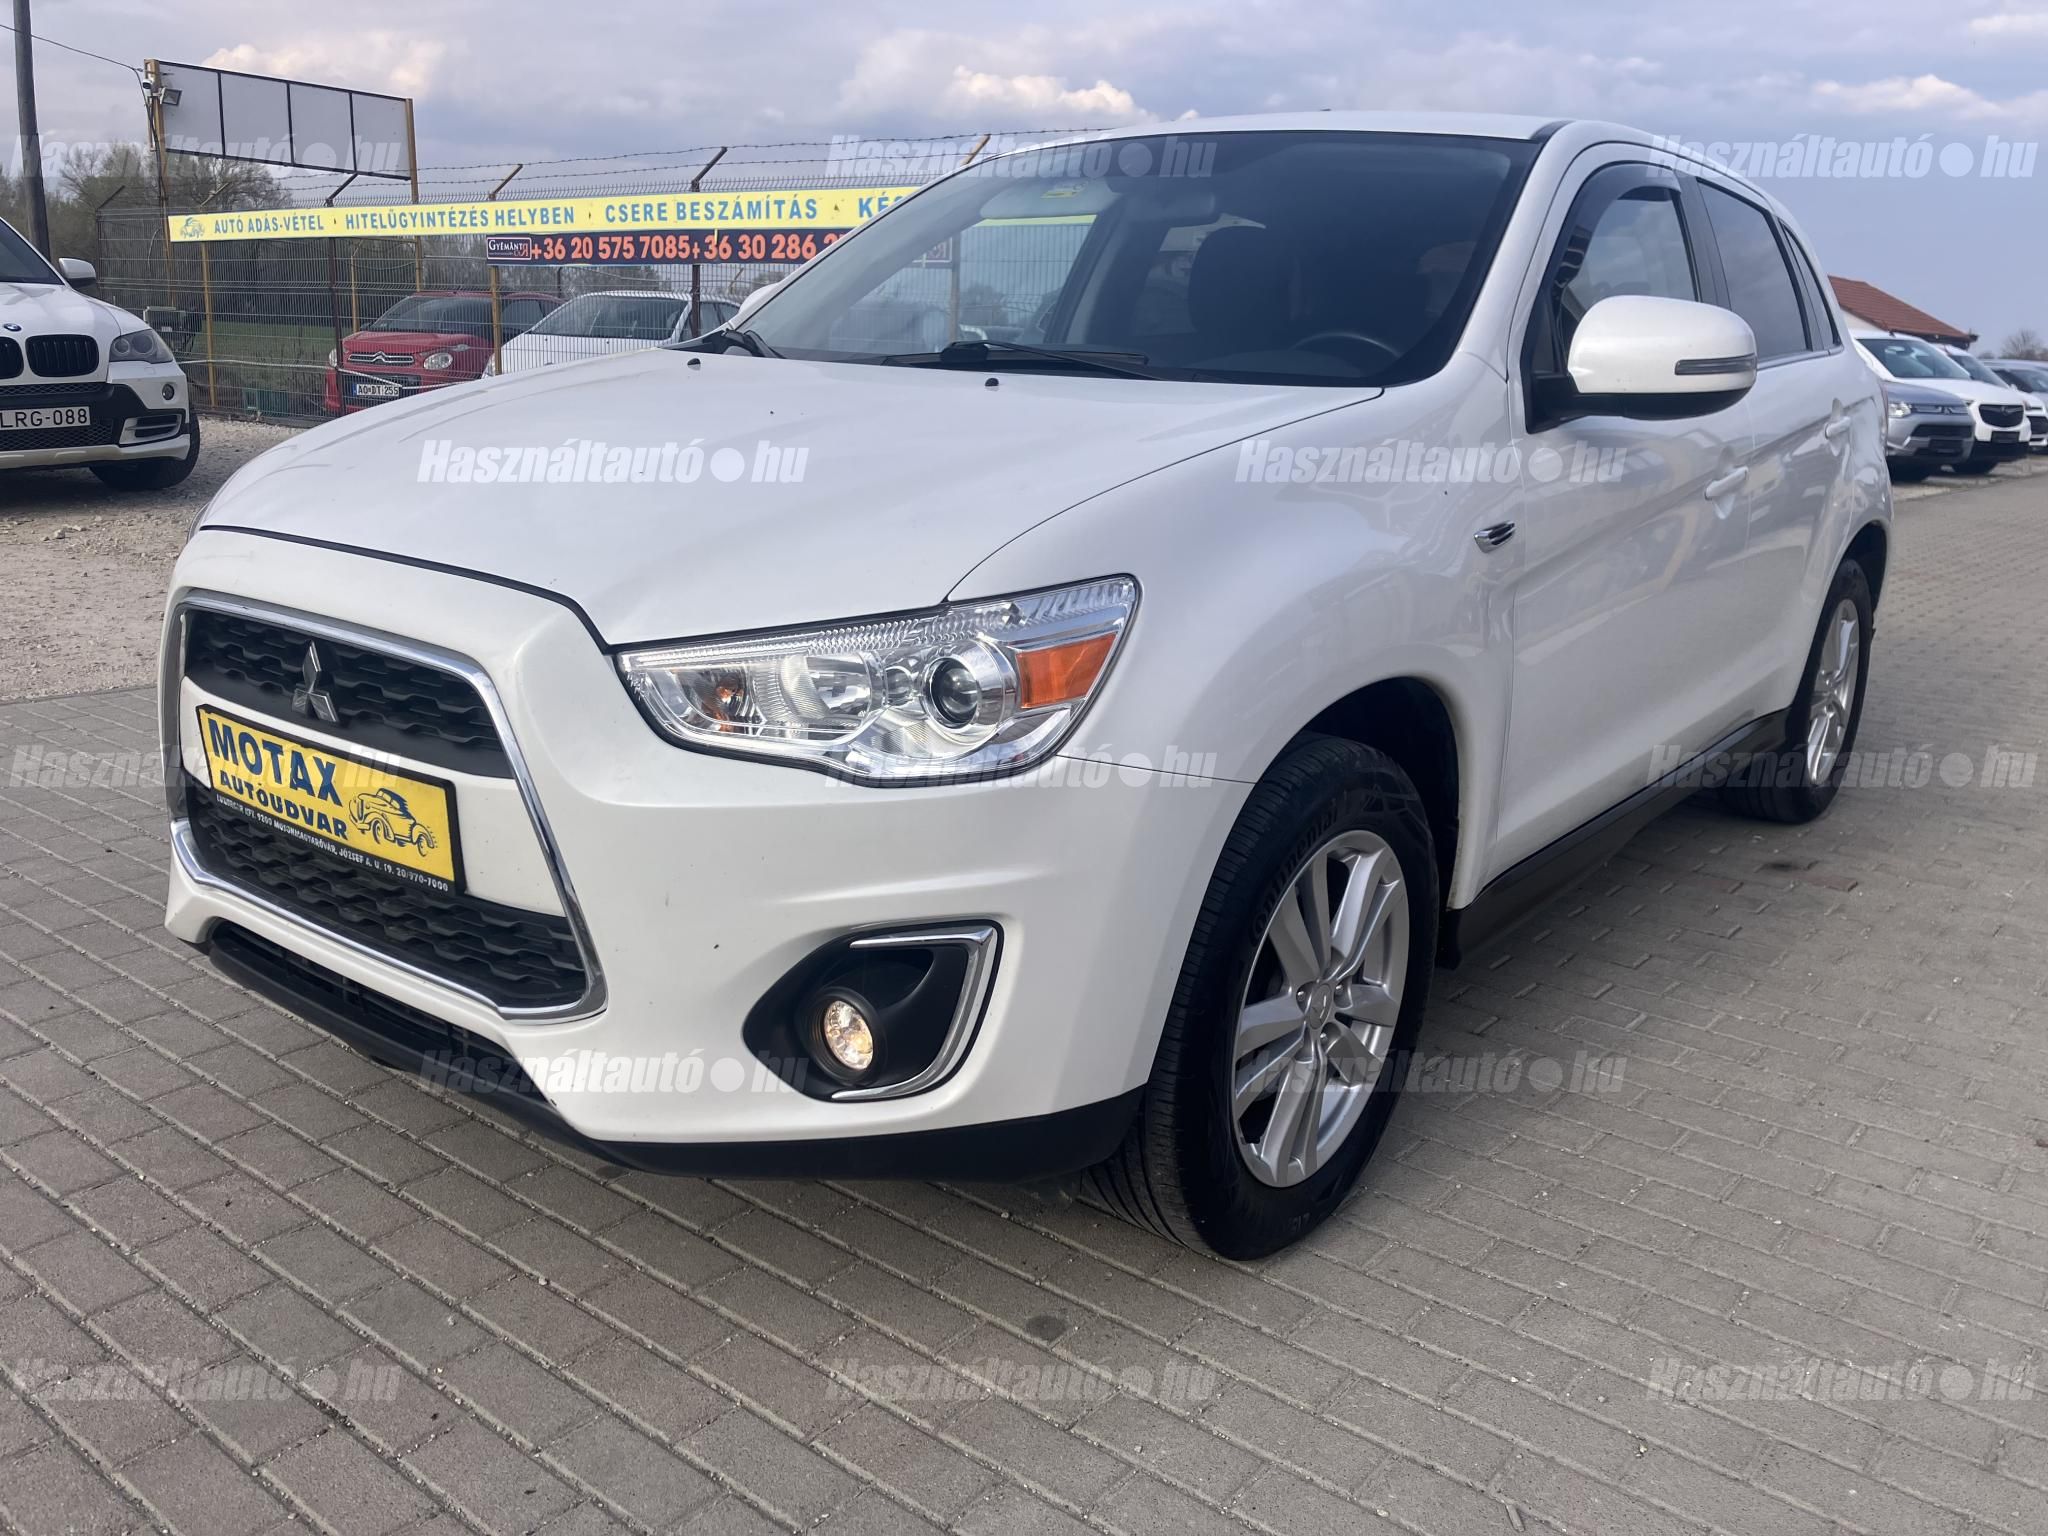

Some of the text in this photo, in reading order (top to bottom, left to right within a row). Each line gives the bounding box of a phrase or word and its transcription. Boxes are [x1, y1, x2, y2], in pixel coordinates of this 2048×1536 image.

[213, 191, 903, 234] AUTÓ ADÁS-VÉTEL HITELÜGYINTÉZÉS HELYBEN CSERE BESZÁMÍTÁS KÉ
[571, 236, 593, 260] 20
[598, 236, 635, 260] 575
[639, 234, 690, 259] 7085
[738, 233, 767, 259] 30
[771, 233, 817, 260] 286
[0, 408, 88, 428] LRG-088
[207, 717, 343, 808] MOTAX
[219, 769, 349, 841] AUTÓUDVAR
